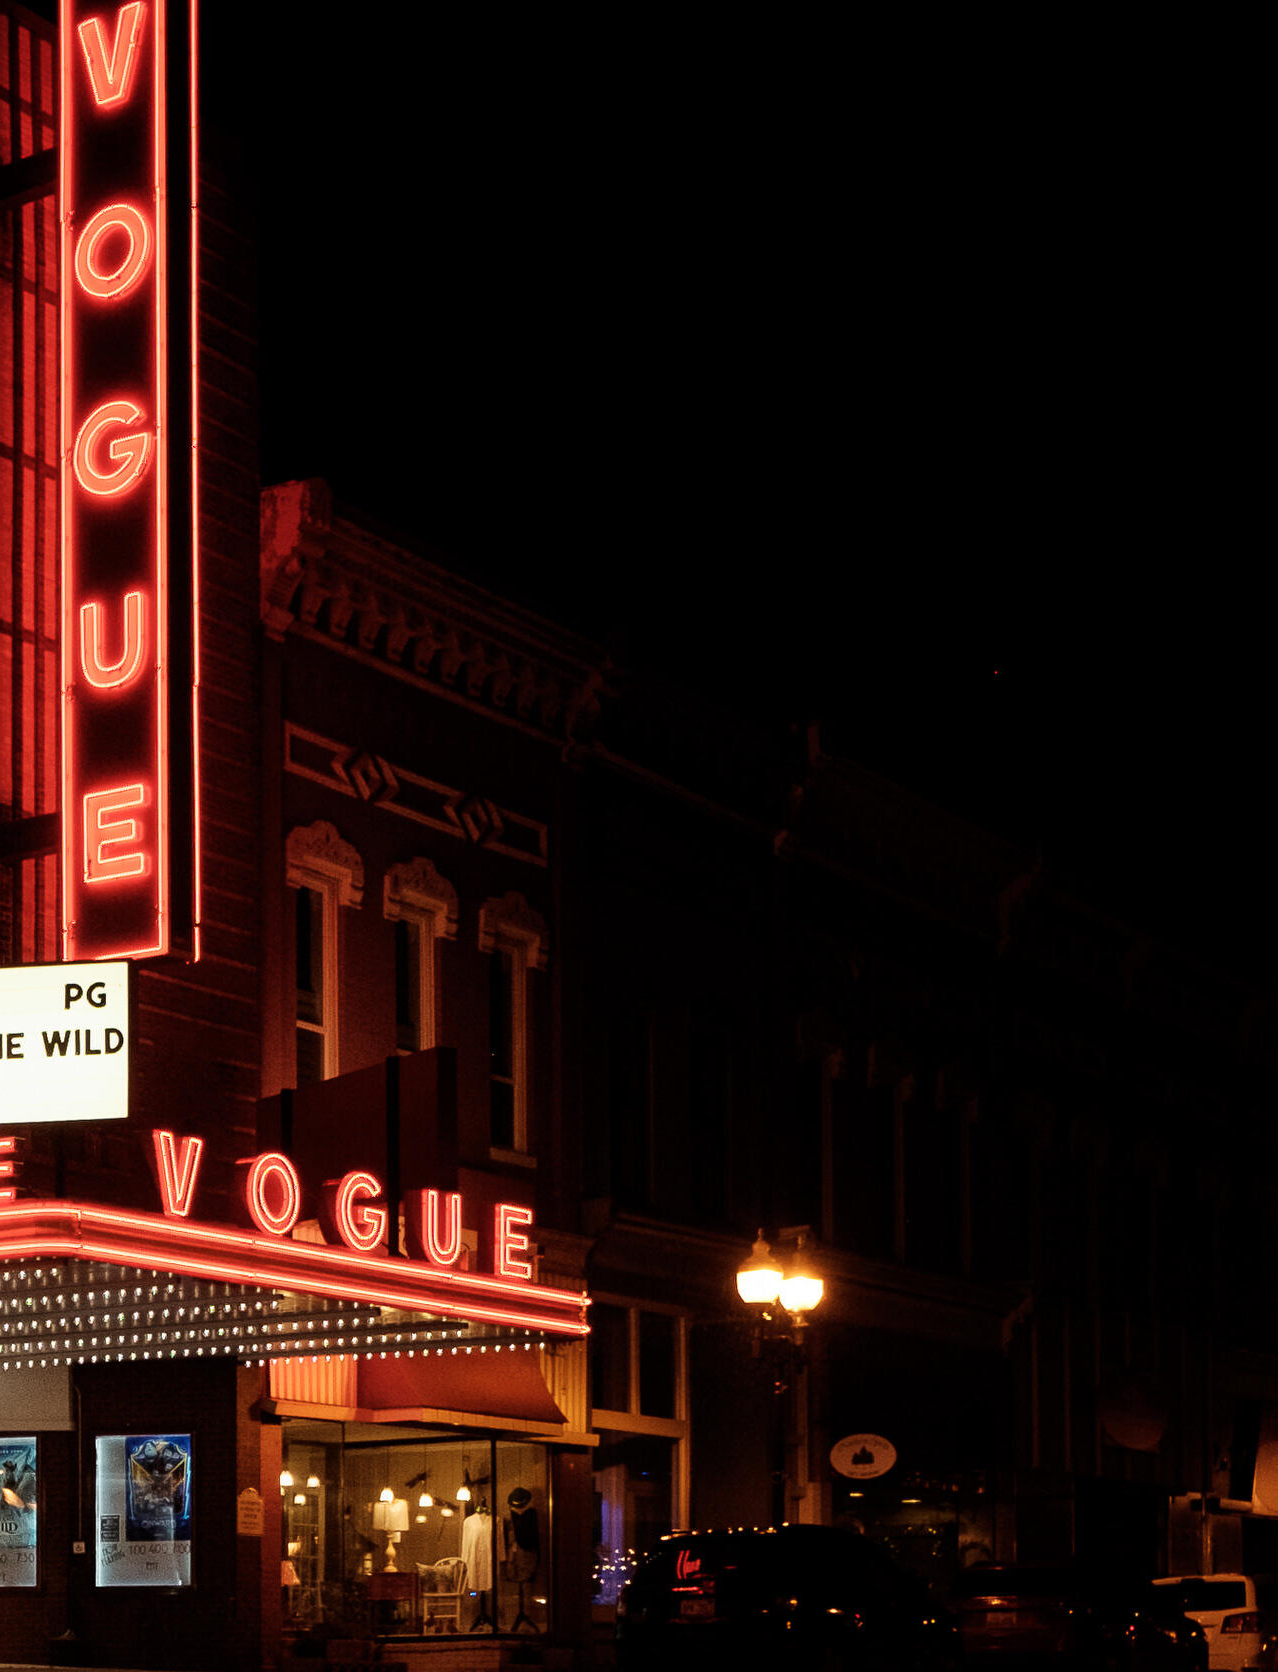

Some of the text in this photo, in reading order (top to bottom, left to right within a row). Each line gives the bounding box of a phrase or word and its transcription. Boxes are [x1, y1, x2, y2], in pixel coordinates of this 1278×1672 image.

[74, 1, 151, 886] VOGUE
[65, 982, 107, 1010] PG
[42, 1027, 124, 1057] WILD
[153, 1129, 533, 1281] VOGUE
